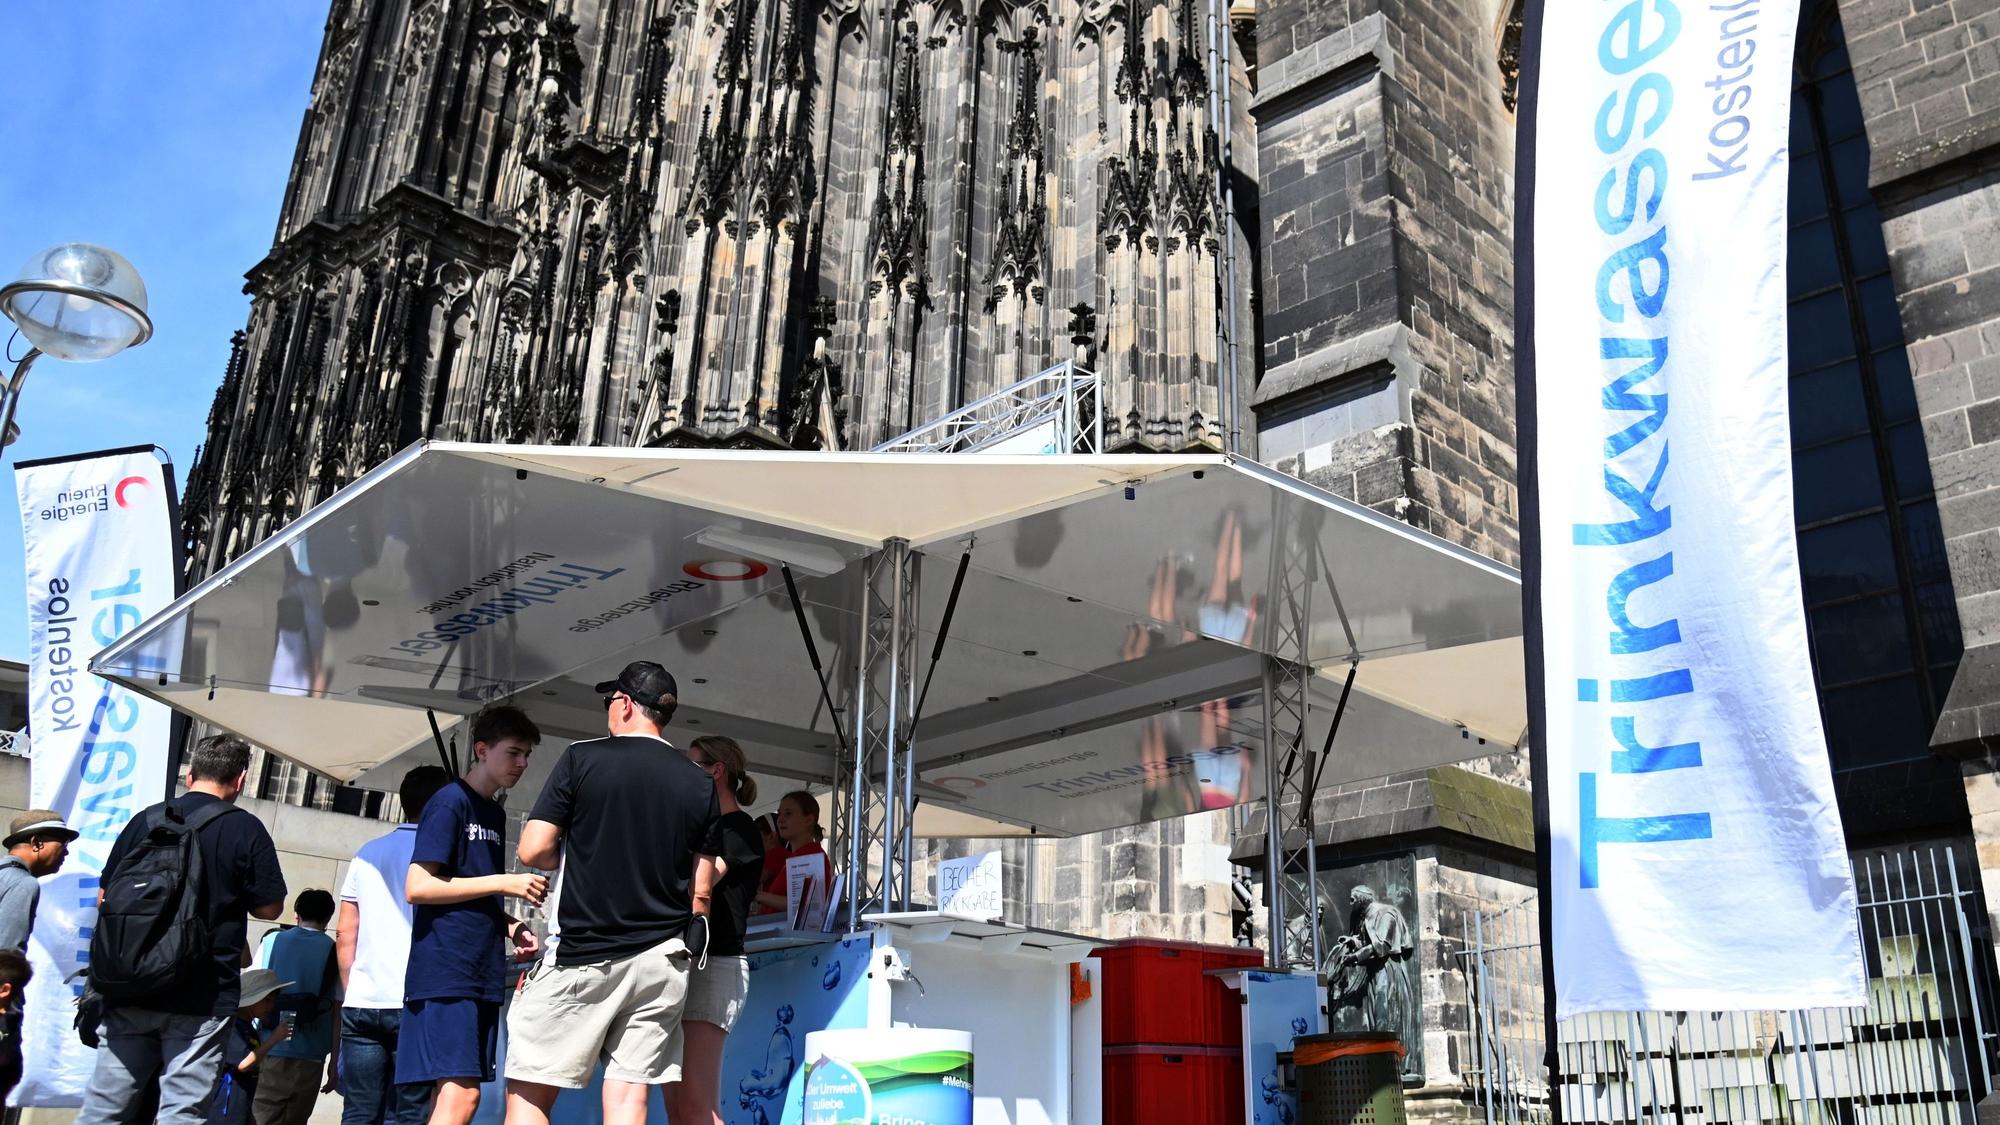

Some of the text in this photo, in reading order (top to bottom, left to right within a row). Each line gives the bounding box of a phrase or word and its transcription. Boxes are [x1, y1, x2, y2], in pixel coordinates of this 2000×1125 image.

[1573, 0, 1713, 889] Trinkwasse
[390, 563, 626, 657] Trinkwasser
[568, 580, 706, 633] RheinEnergie
[978, 750, 1099, 780] RheinEnergie
[1023, 741, 1255, 793] Trinkwasser
[942, 861, 998, 891] BECHER
